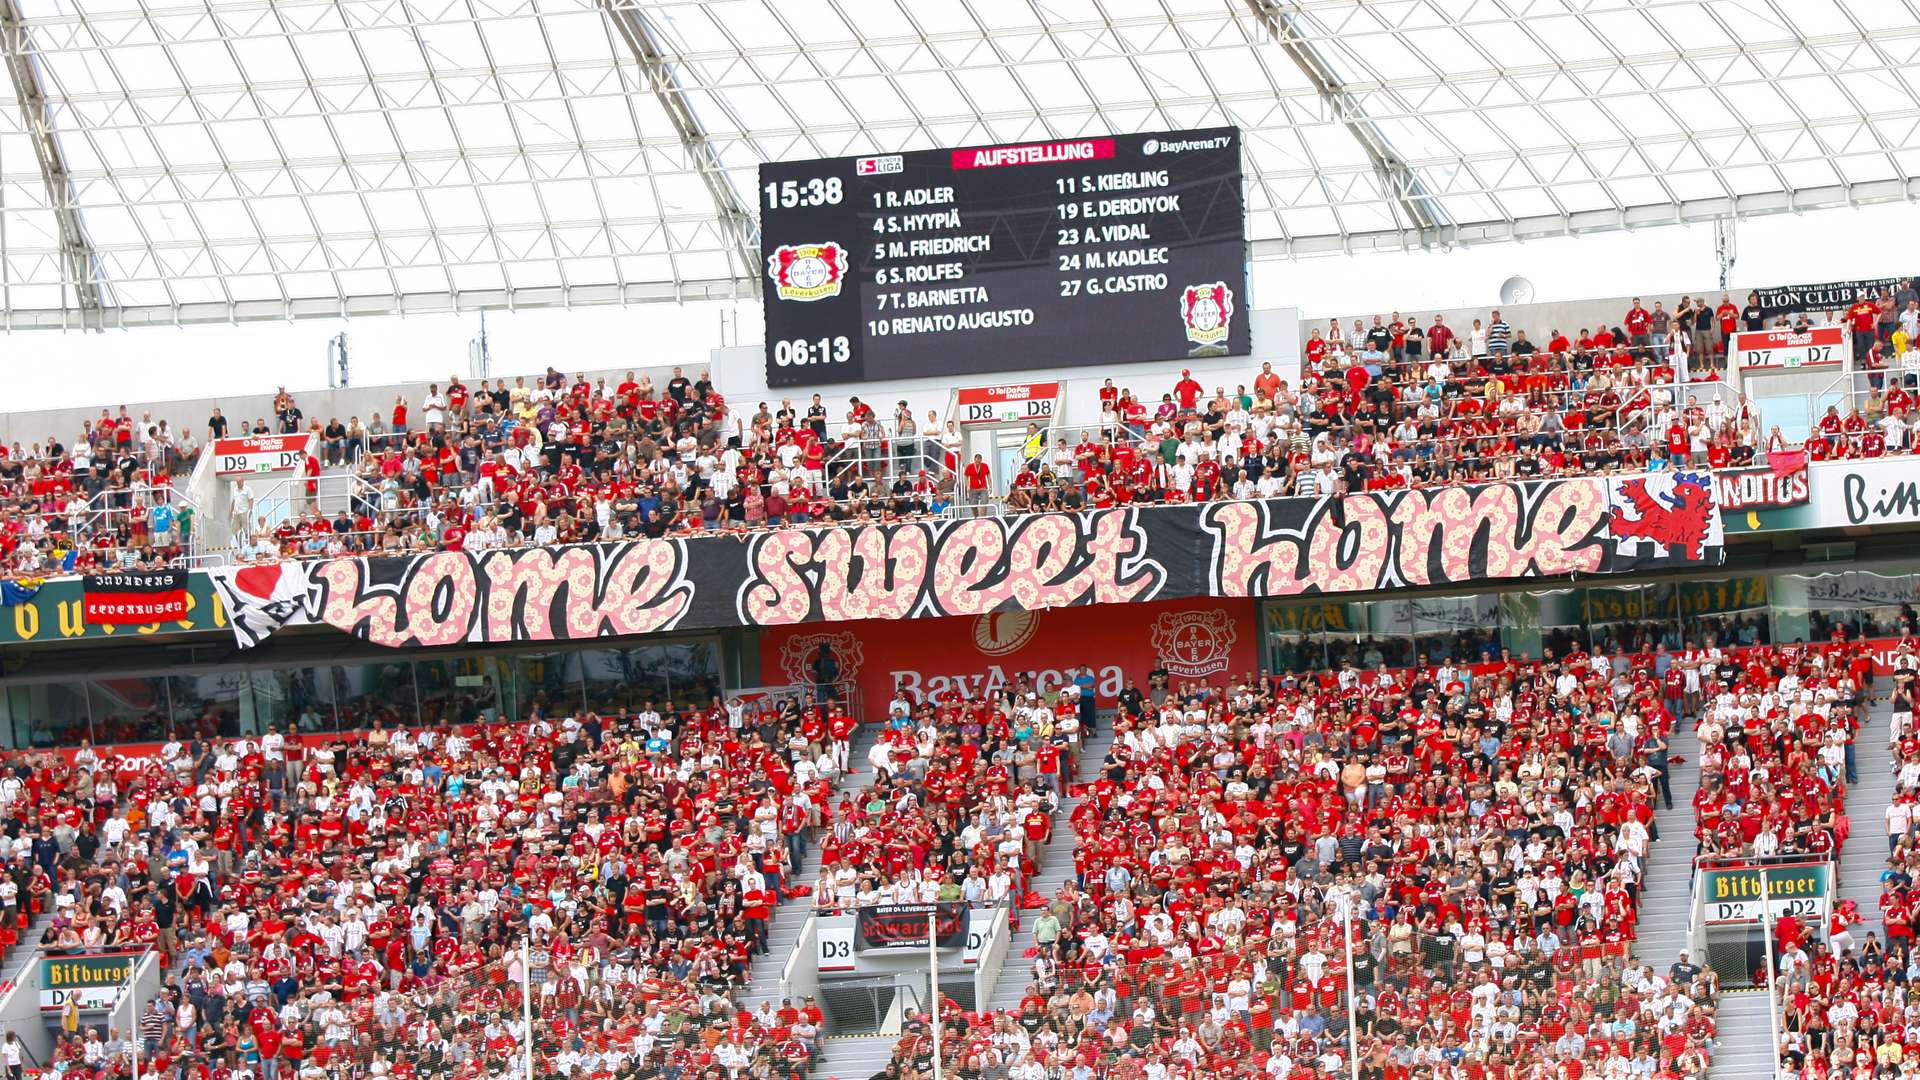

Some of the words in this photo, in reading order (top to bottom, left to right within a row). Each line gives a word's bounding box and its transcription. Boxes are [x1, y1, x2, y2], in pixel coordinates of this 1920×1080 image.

[974, 143, 1094, 167] AUFSTELLUNG
[878, 163, 902, 172] LIGA
[765, 177, 843, 208] 15:38
[1056, 178, 1076, 194] 11
[873, 192, 882, 208] 1
[903, 187, 954, 206] ADLER
[1057, 203, 1079, 219] 19
[1099, 195, 1180, 217] DERDIYOK
[873, 217, 884, 233] 4
[904, 208, 961, 231] HYYPIÄ
[1058, 229, 1079, 245] 23
[1102, 223, 1150, 242] VIDAL
[875, 243, 885, 259] 5
[910, 235, 990, 257] FRIEDRICH
[1059, 255, 1081, 271] 24
[1107, 247, 1169, 267] KADLEC
[876, 269, 887, 285] 6
[906, 262, 963, 281] ROLFES
[1060, 280, 1082, 296] 27
[1105, 273, 1168, 293] CASTRO
[877, 294, 887, 310] 7
[907, 287, 988, 308] BARNETTA
[1761, 293, 1800, 309] LION
[1805, 288, 1852, 305] CLUB
[868, 319, 889, 336] 10
[892, 314, 955, 334] RENATO
[958, 308, 1034, 330] AUGUSTO
[775, 336, 850, 366] 06:13
[1748, 350, 1772, 366] D7
[1808, 347, 1832, 362] D7
[996, 386, 1031, 396] TelDaFax
[1006, 392, 1031, 400] ENERGY
[968, 404, 993, 420] D8
[1027, 400, 1052, 416] D8
[224, 456, 247, 471] D9
[743, 509, 1160, 625] sweet
[1210, 479, 1606, 598] home
[1176, 639, 1212, 648] BAYER
[1167, 660, 1223, 675] Leverkusen
[1719, 903, 1744, 919] D2
[1790, 899, 1816, 916] D2
[822, 941, 850, 958] D3
